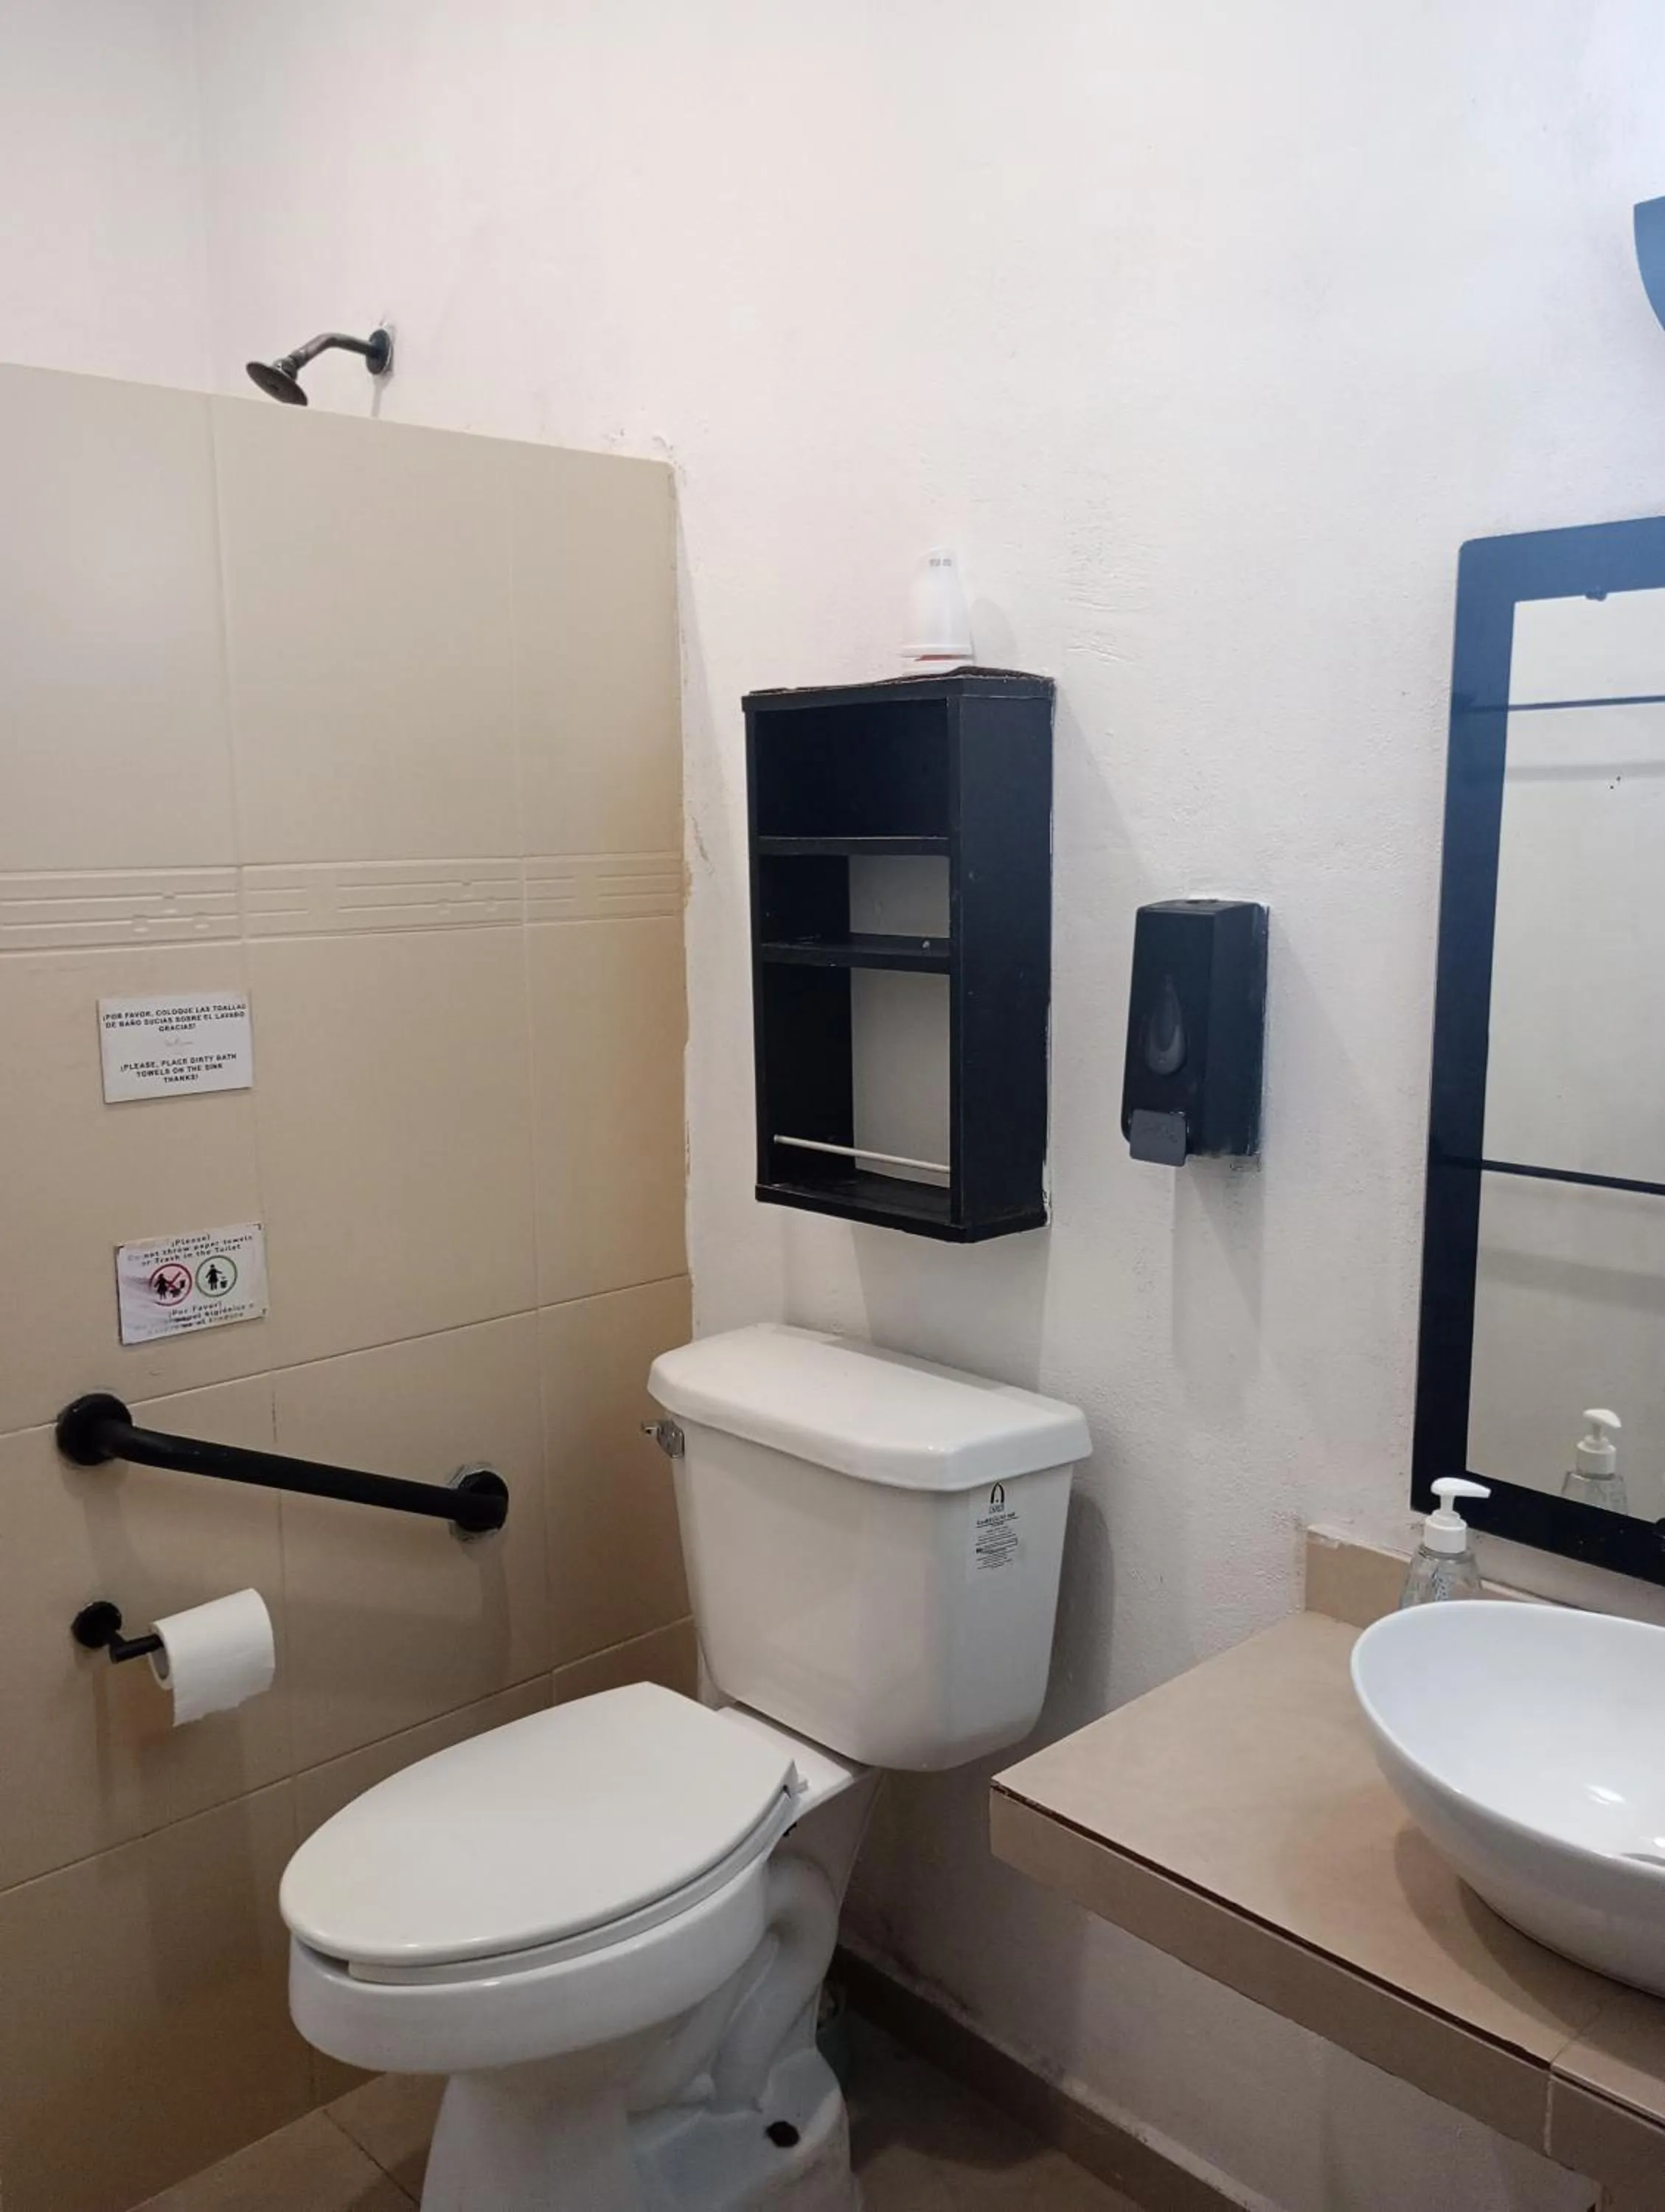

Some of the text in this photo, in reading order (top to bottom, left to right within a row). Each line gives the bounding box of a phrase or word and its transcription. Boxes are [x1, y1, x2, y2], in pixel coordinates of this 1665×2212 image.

[144, 1017, 173, 1026] SUCIAS
[175, 1014, 202, 1022] SOBRE
[161, 1057, 187, 1067] PLACE
[190, 1055, 213, 1064] DIRTY
[216, 1053, 237, 1061] BATH
[136, 1068, 170, 1078] TOWELS
[187, 1065, 201, 1073] THE
[205, 1062, 223, 1071] SINK
[143, 1251, 159, 1259] not
[162, 1246, 190, 1256] throw
[194, 1241, 219, 1251] paper
[154, 1255, 180, 1264] Trash
[196, 1249, 212, 1257] the
[214, 1244, 241, 1253] Toilet
